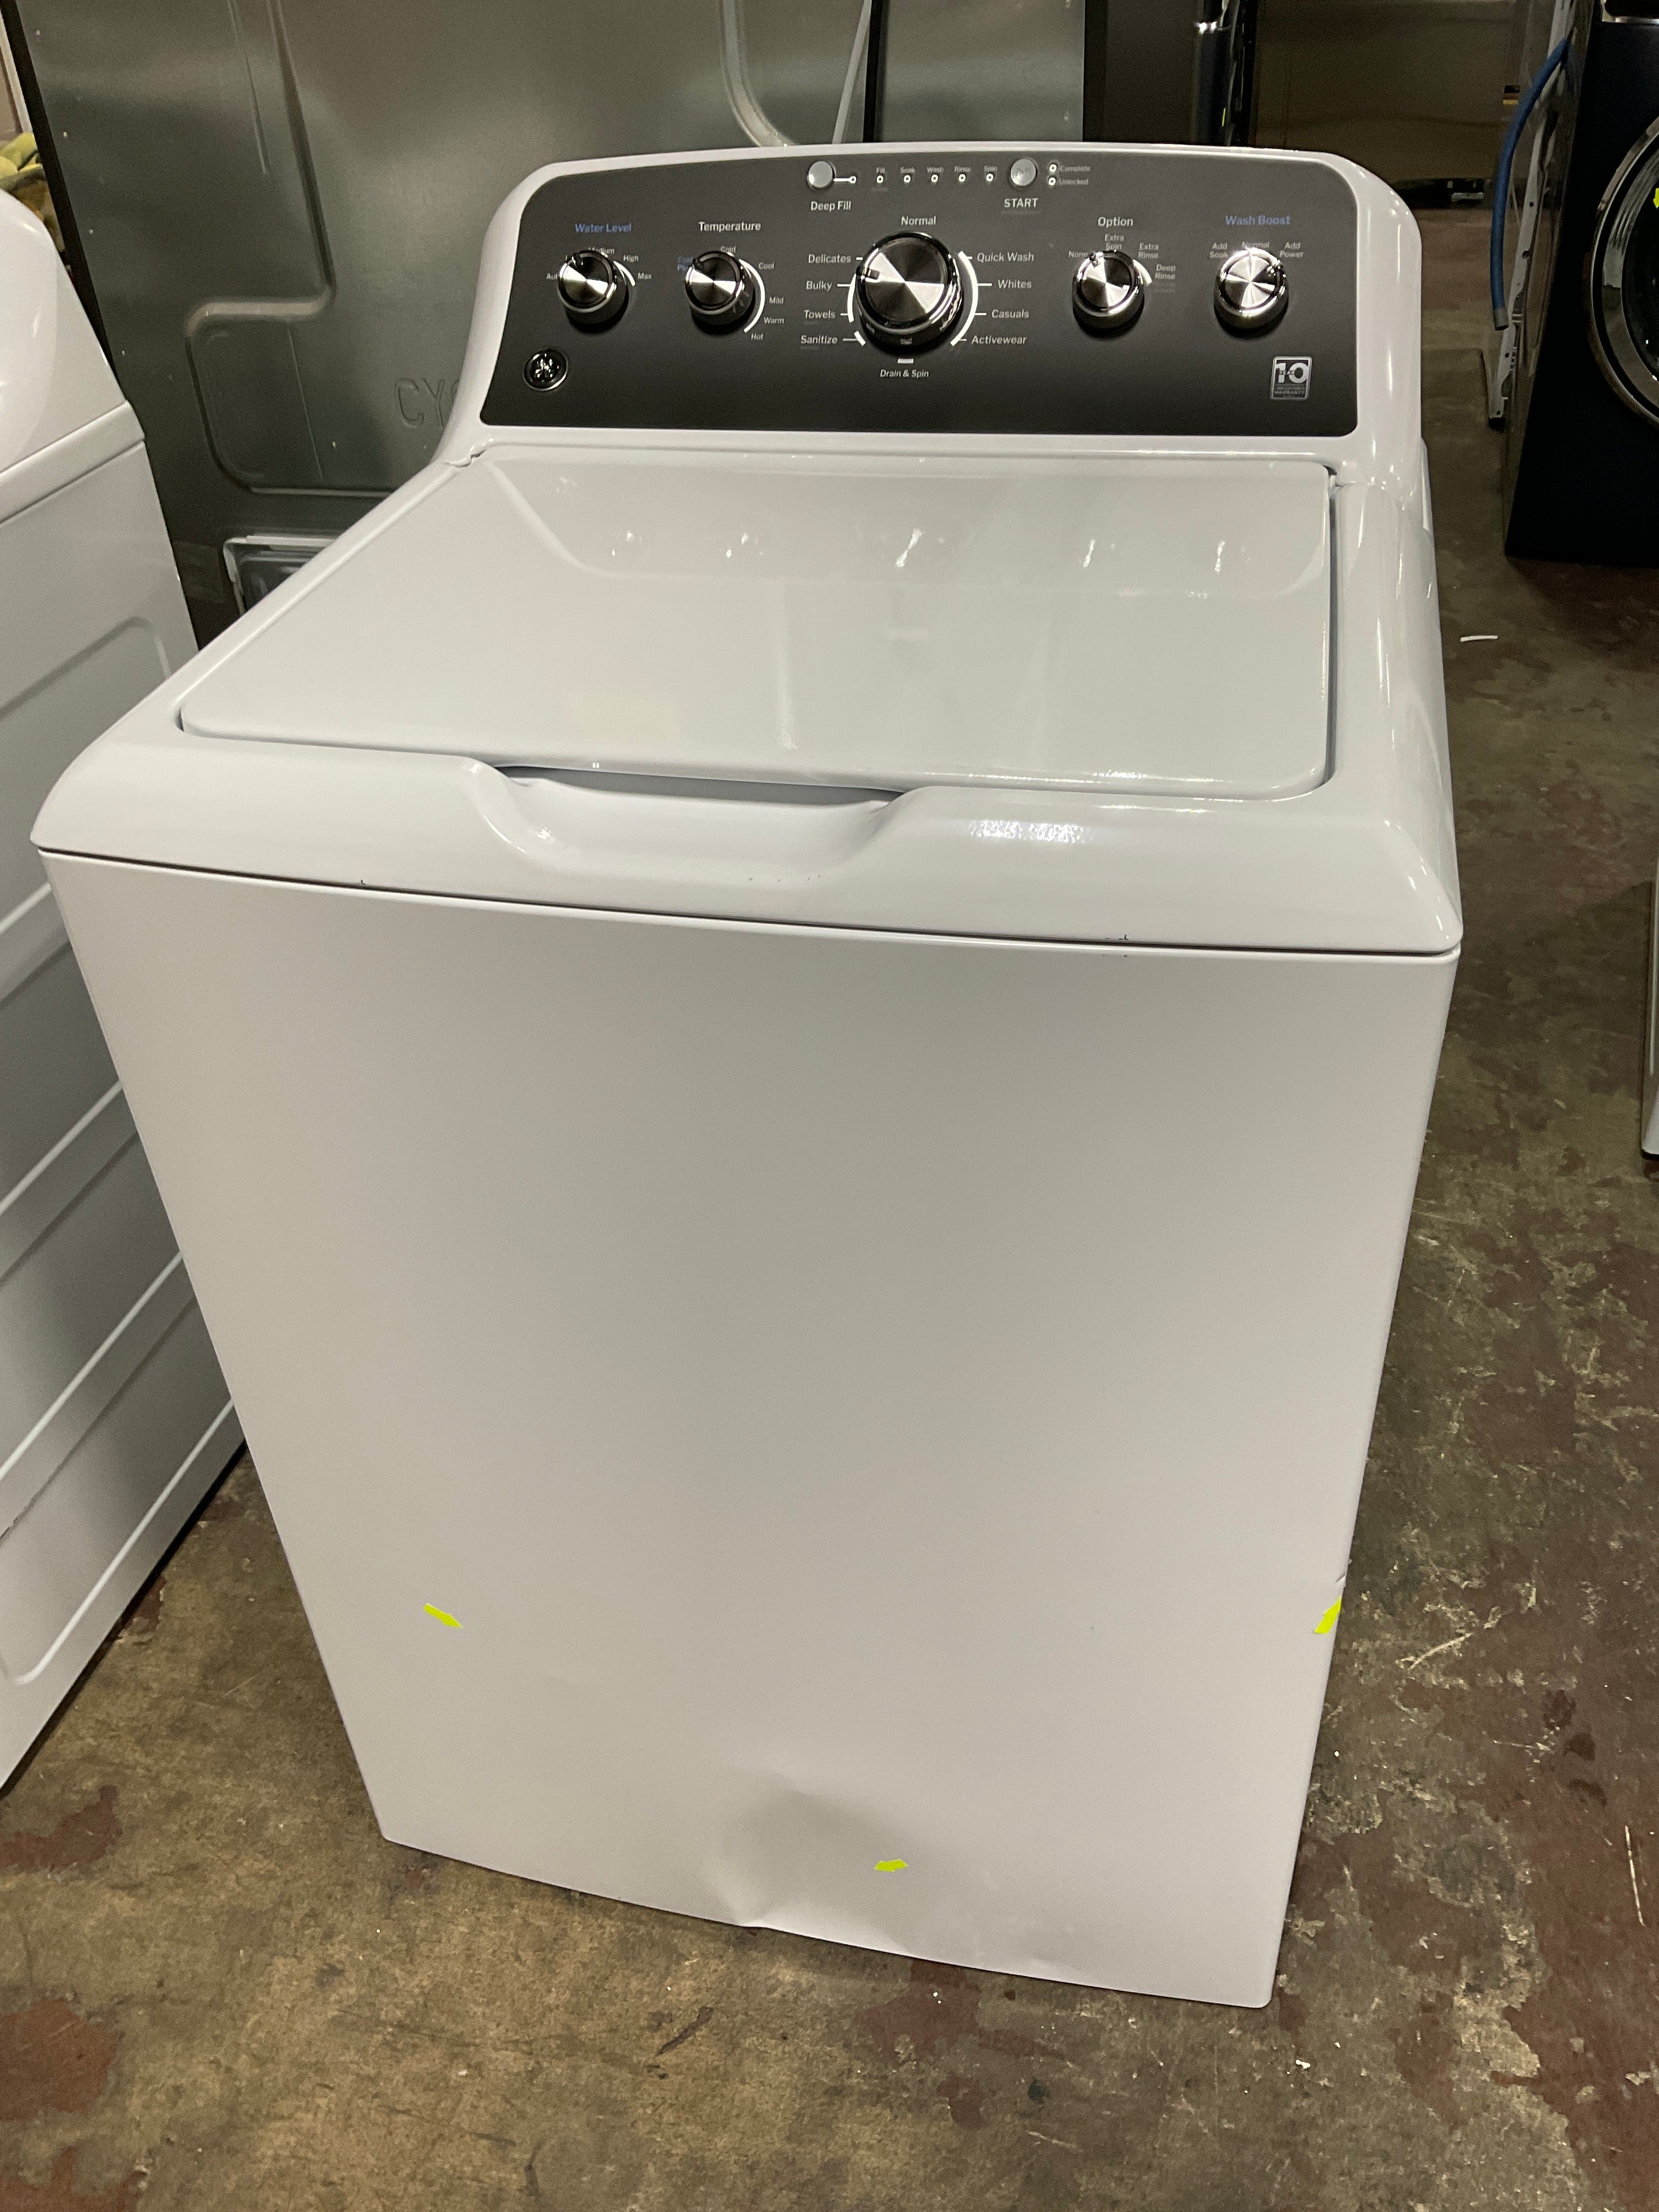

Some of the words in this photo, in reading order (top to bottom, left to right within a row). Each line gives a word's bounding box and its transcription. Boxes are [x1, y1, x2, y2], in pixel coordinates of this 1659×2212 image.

[810, 201, 835, 212] Deep
[838, 201, 851, 210] Fill
[1004, 198, 1039, 208] START
[901, 216, 936, 225] Normal
[1098, 217, 1133, 228] Option
[1226, 216, 1255, 225] Wash
[1258, 215, 1291, 225] Boost
[575, 224, 603, 233] Water
[606, 223, 631, 232] Level
[698, 221, 761, 233] Temperature
[623, 255, 639, 263] High
[808, 254, 851, 263] Delicates
[977, 252, 1005, 263] Quick
[1008, 252, 1034, 262] Wash
[1156, 264, 1176, 273] Deep
[806, 280, 832, 291] Bulky
[998, 279, 1032, 289] Whites
[804, 309, 836, 318] Towels
[991, 309, 1029, 318] Casuals
[800, 335, 838, 344] Sanitize
[972, 335, 1026, 345] Activewear
[880, 369, 901, 377] Drain
[911, 369, 929, 379] Spin
[1275, 362, 1309, 383] 10
